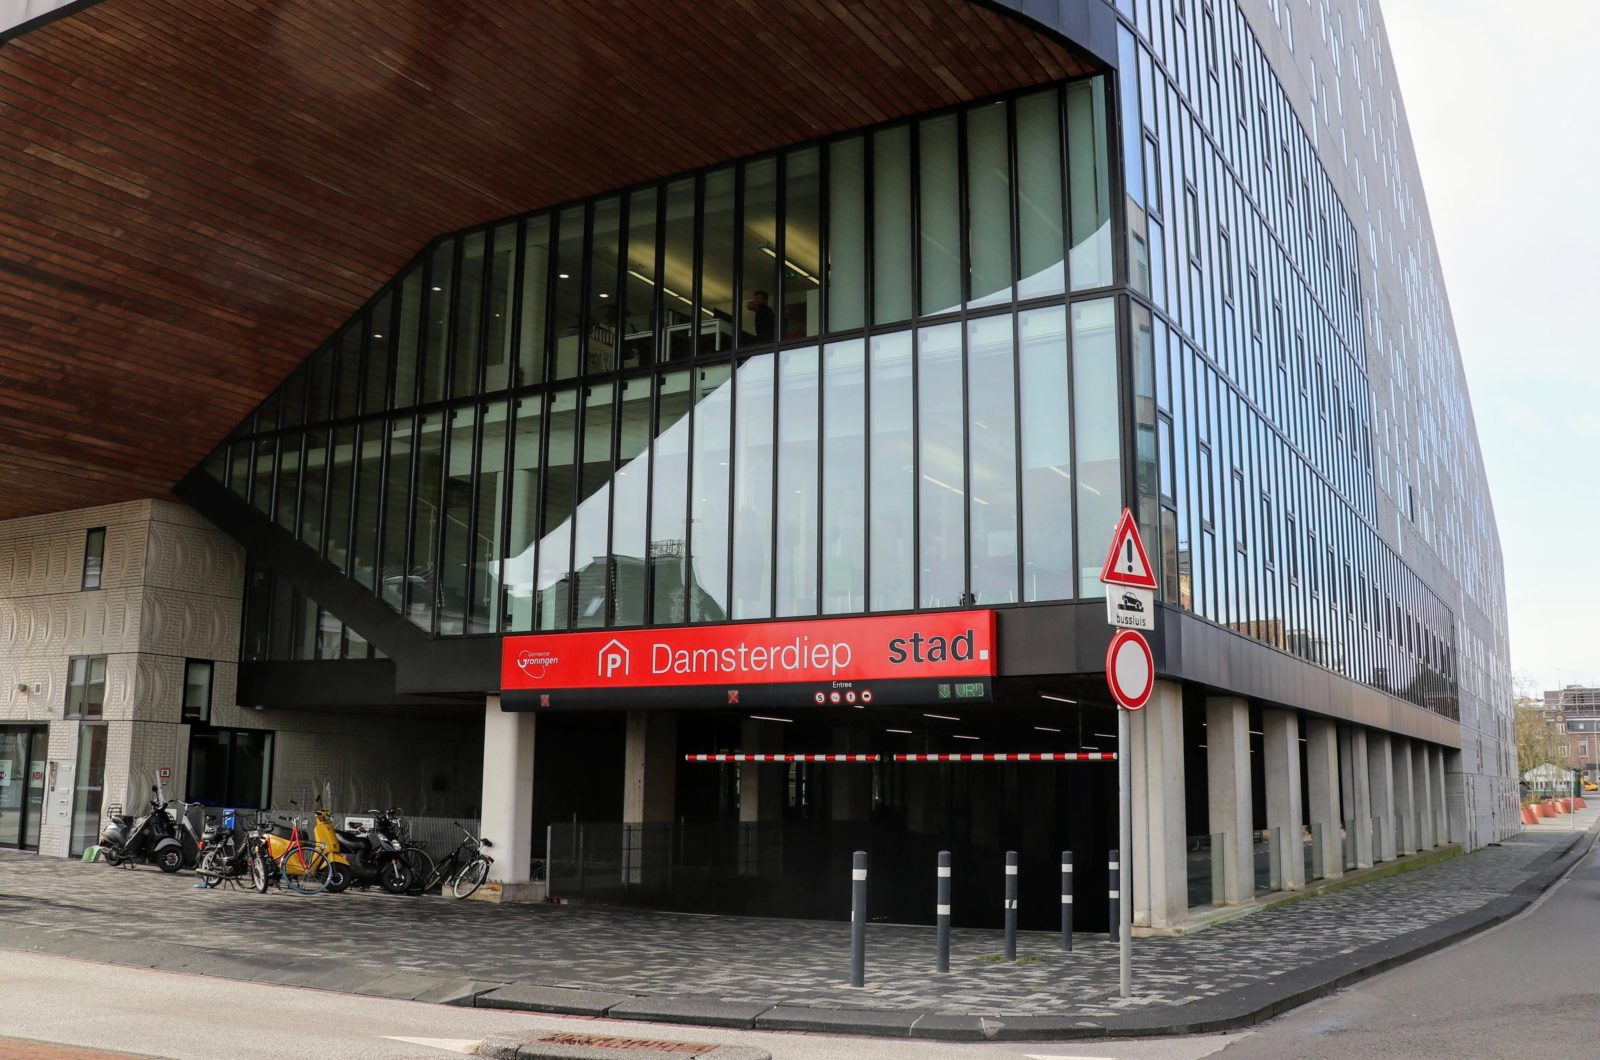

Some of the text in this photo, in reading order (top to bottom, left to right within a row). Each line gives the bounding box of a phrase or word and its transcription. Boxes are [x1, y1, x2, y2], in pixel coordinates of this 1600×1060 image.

[1116, 614, 1146, 627] bussluis
[517, 657, 558, 668] Groningen
[606, 653, 622, 678] P
[651, 636, 852, 676] Damsterdiep
